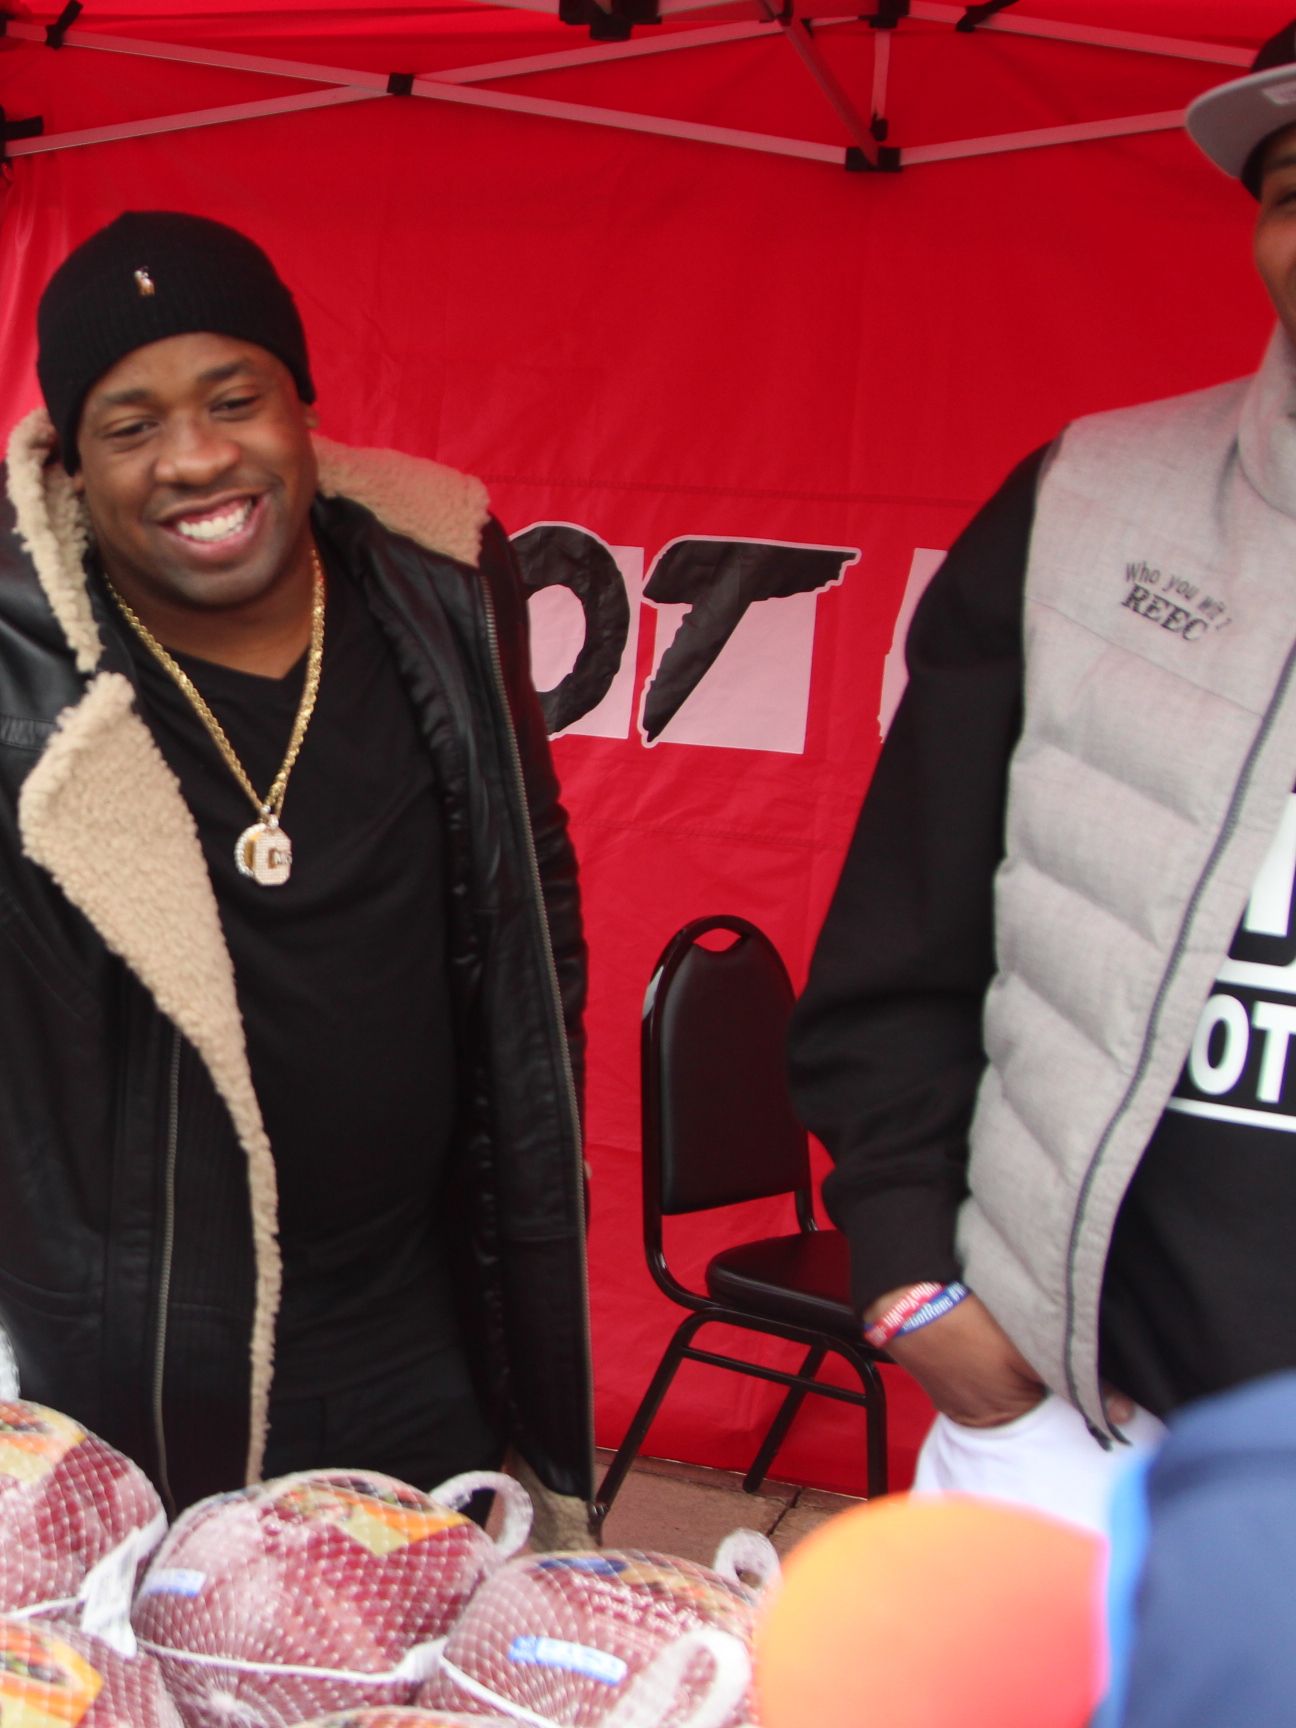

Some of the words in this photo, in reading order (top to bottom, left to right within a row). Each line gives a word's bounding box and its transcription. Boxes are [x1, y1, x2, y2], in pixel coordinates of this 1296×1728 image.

[1125, 560, 1161, 583] Who
[1161, 574, 1200, 600] you
[1120, 582, 1209, 641] REEC
